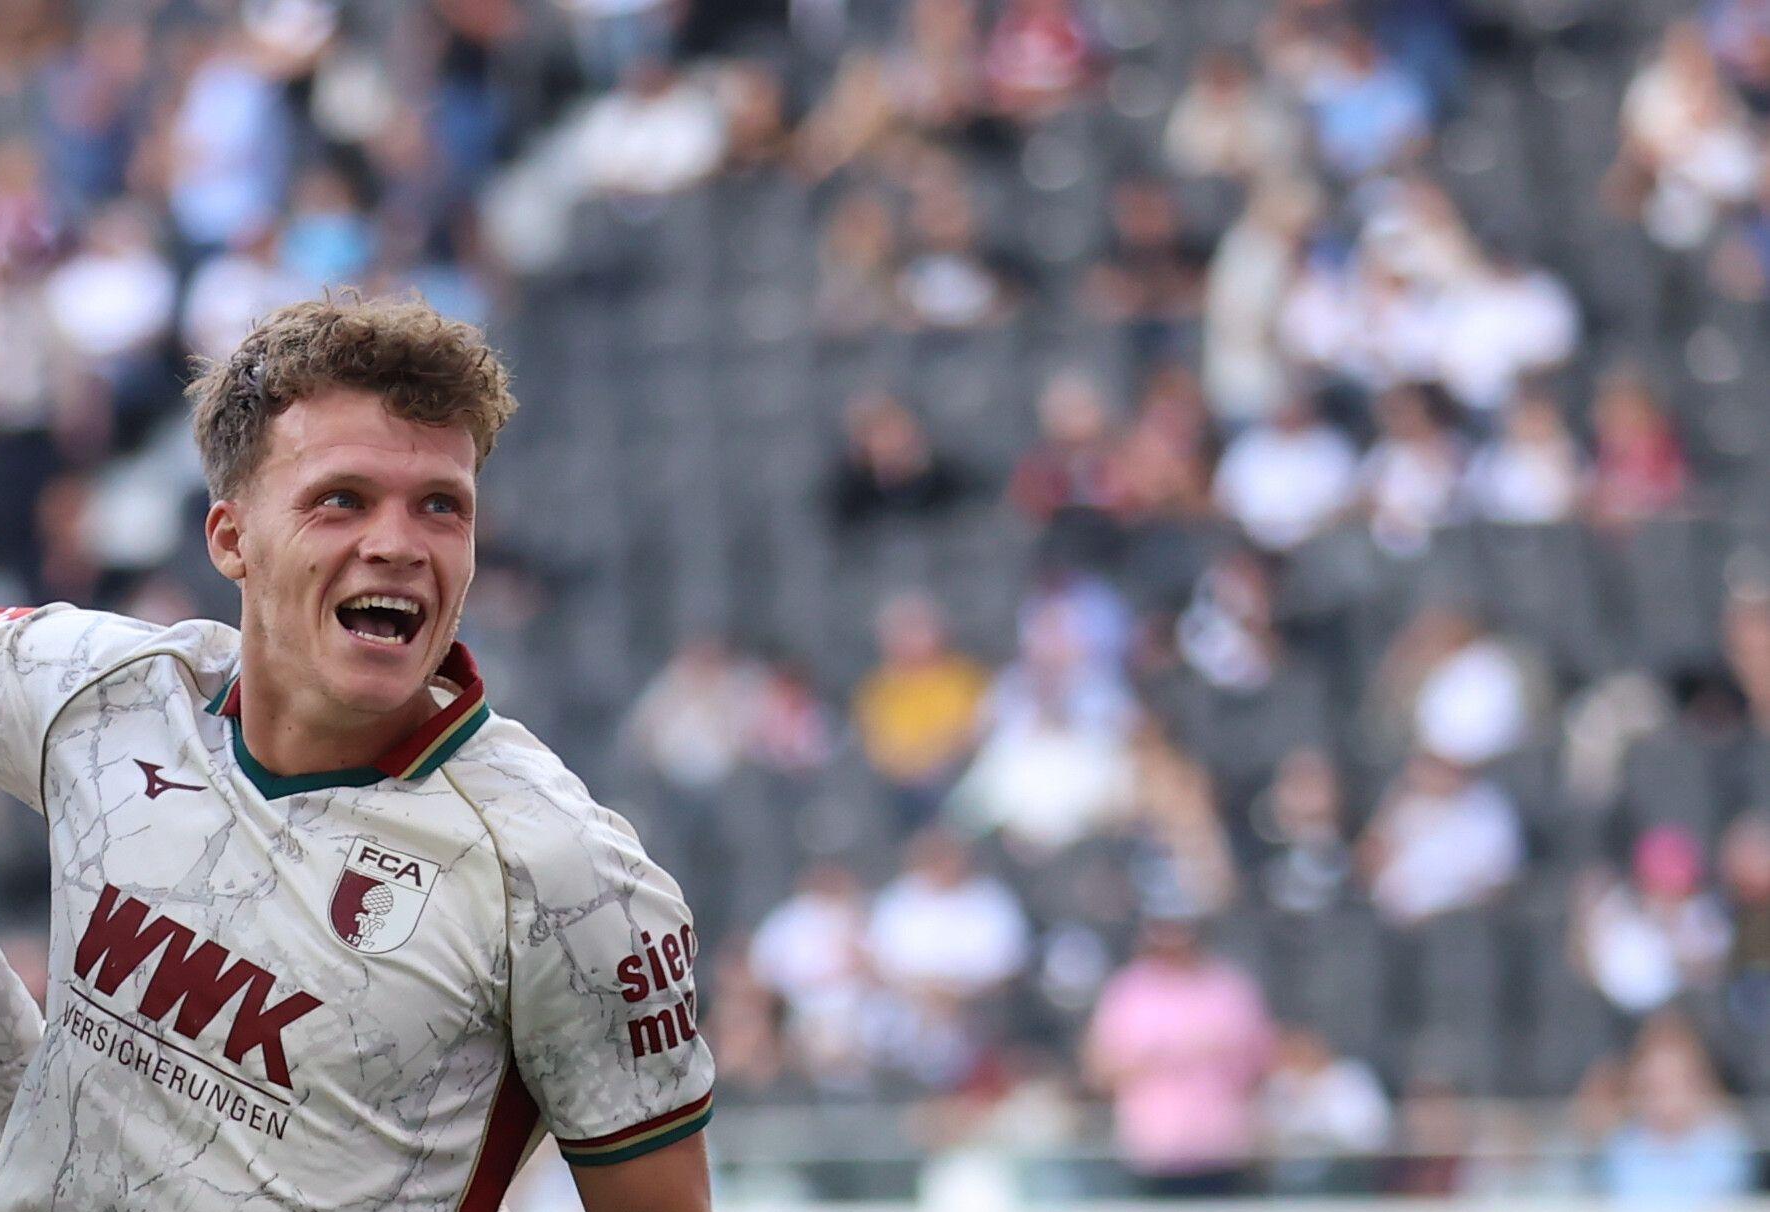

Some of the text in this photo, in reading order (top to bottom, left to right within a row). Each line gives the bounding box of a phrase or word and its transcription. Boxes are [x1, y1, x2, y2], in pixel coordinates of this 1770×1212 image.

[358, 845, 422, 887] FCA
[73, 883, 326, 1091] WWK
[63, 1000, 290, 1141] VERSICHERUNGEN
